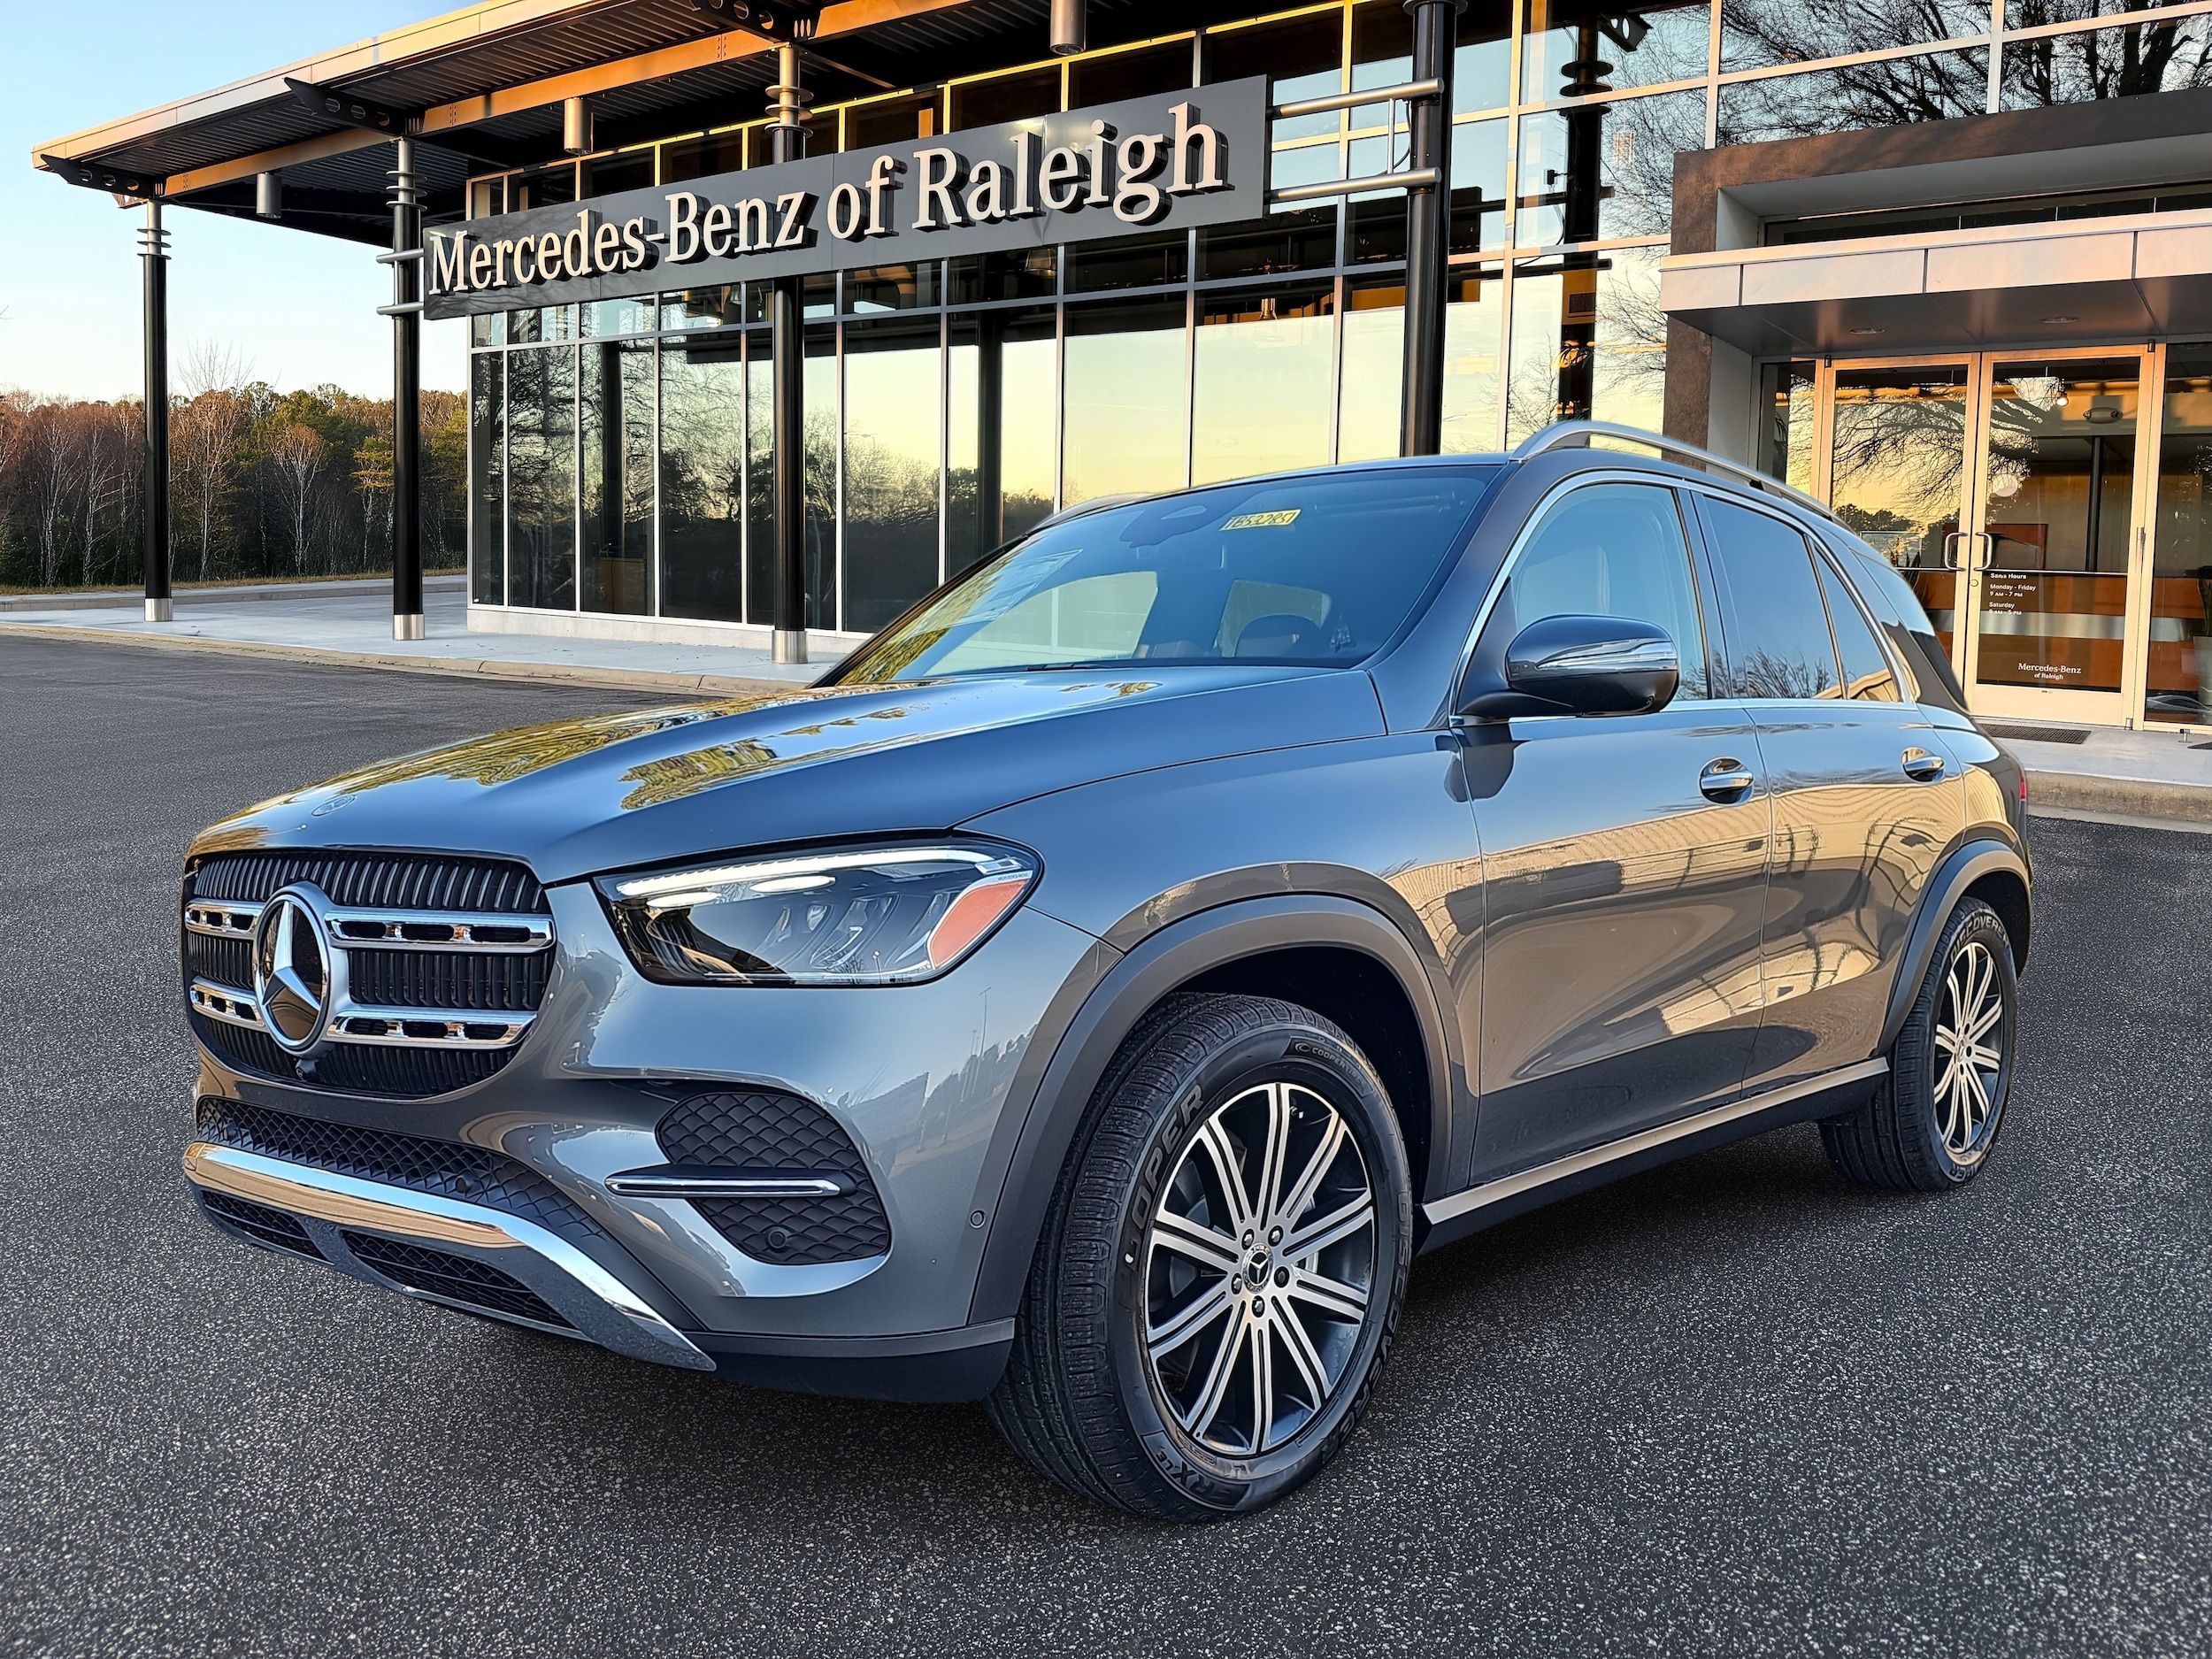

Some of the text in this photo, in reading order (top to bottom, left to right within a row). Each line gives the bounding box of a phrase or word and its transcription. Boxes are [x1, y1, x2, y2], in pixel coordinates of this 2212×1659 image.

[428, 102, 1230, 296] Mercedes-Benz of Raleigh
[2018, 662, 2082, 674] Mercedes-Benz
